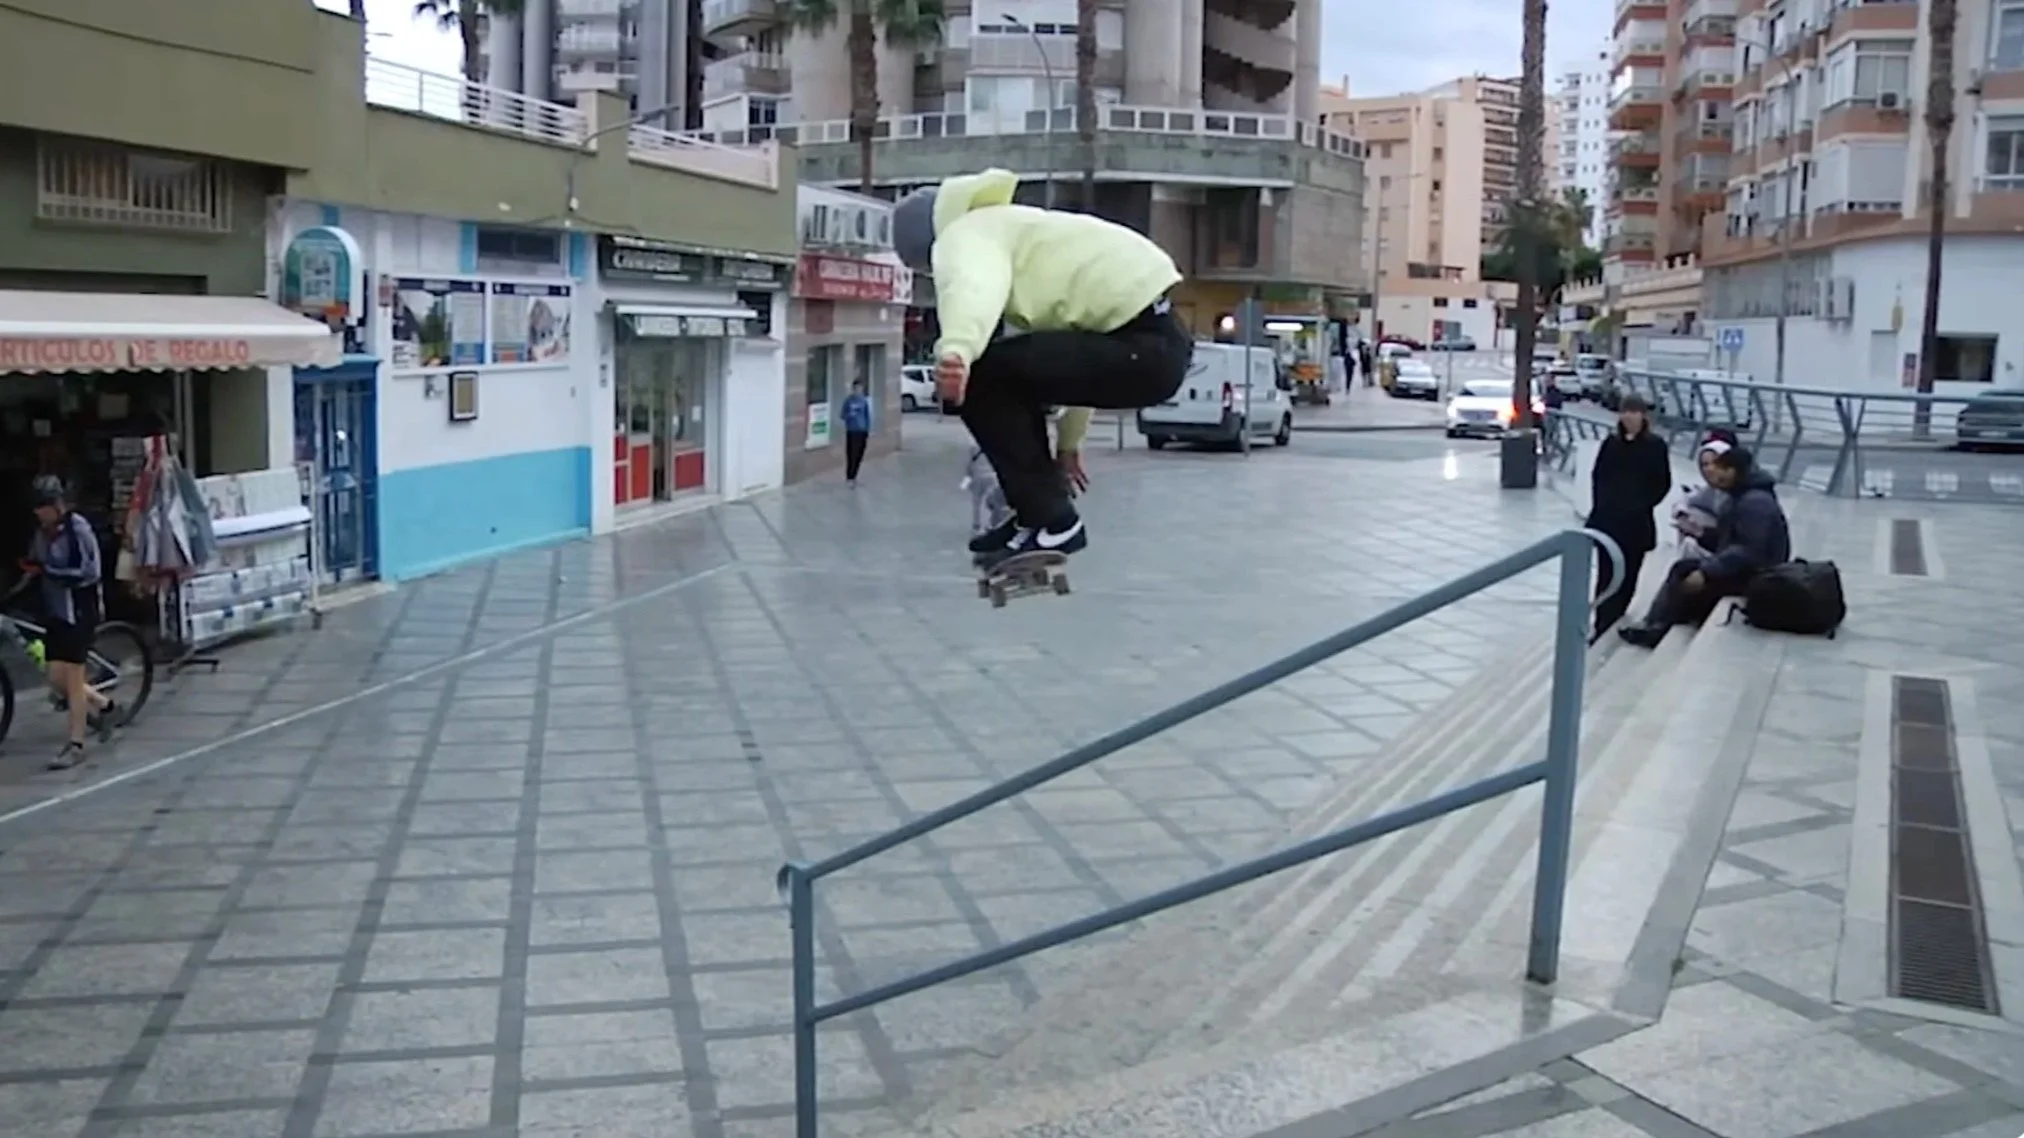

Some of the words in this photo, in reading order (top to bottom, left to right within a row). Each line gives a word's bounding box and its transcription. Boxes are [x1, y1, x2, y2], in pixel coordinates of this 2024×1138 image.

[0, 339, 116, 363] RTICULOS
[128, 339, 158, 363] DE
[169, 339, 249, 363] REGALO
